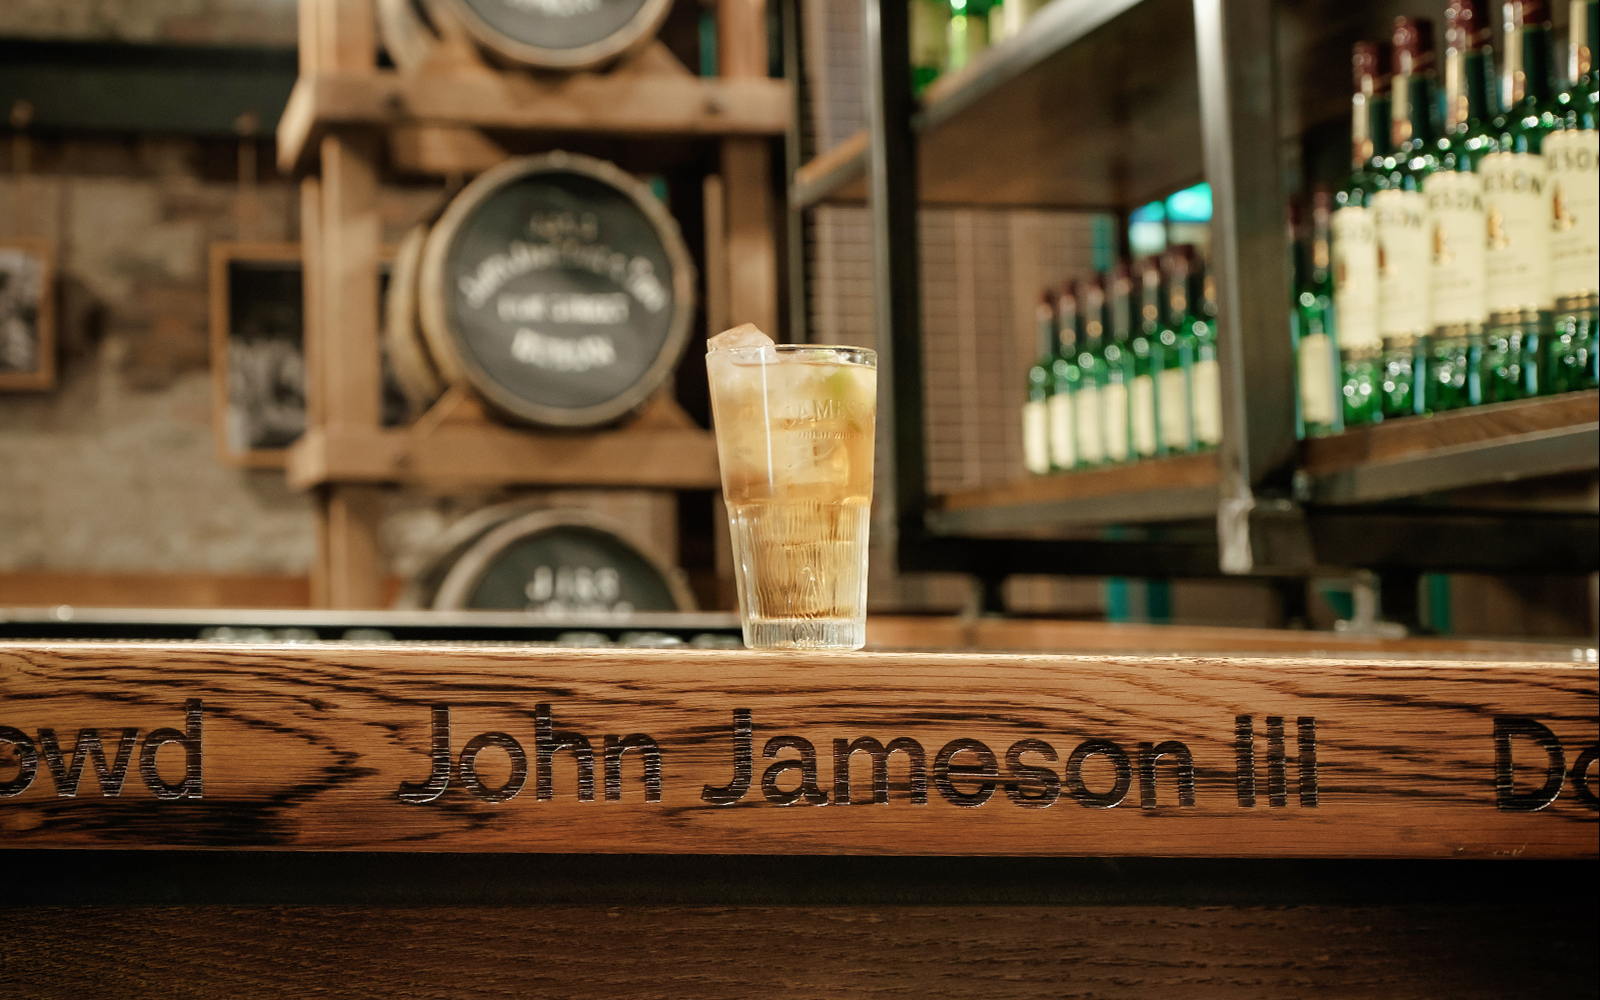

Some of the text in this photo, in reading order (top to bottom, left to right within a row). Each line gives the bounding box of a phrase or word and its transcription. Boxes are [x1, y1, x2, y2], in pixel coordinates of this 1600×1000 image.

[399, 703, 1320, 810] John Jameson III
